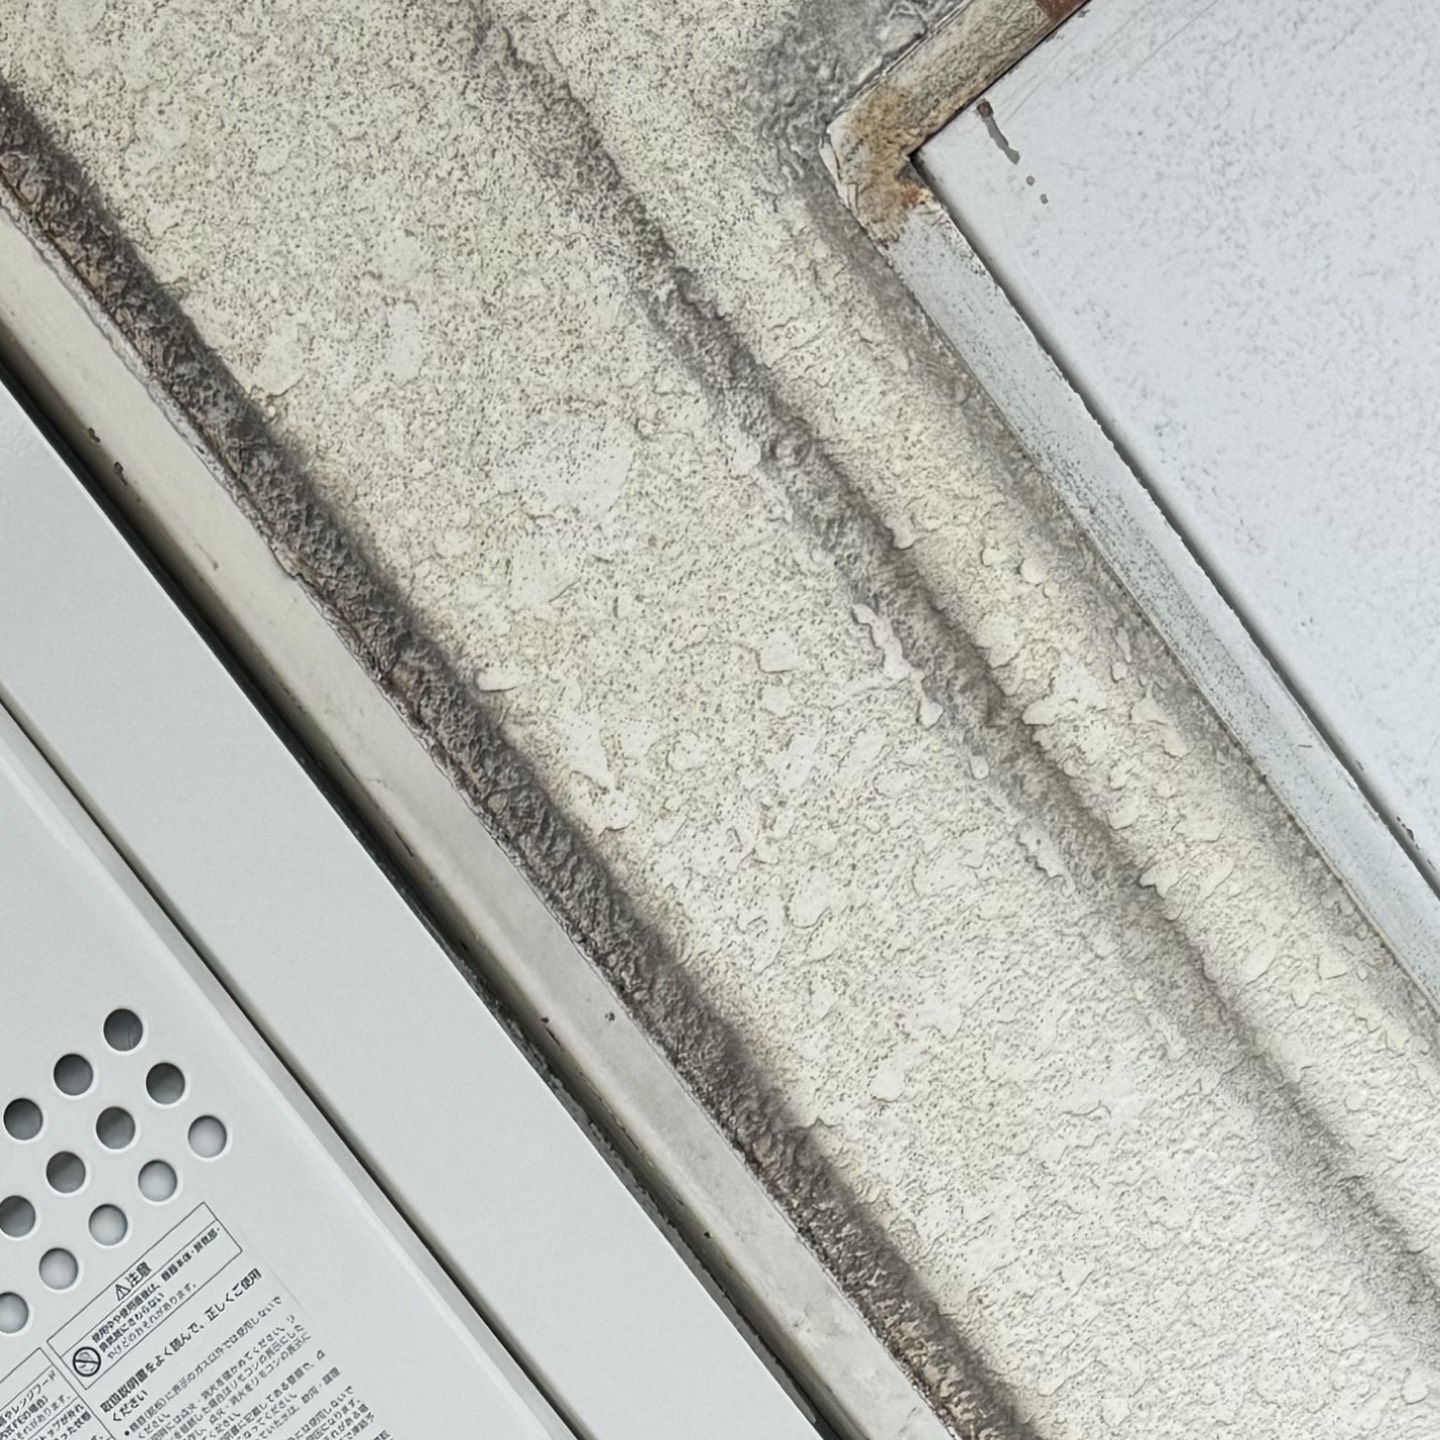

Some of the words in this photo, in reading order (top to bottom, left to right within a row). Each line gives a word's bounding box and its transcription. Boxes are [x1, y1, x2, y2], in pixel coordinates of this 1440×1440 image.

[125, 1260, 152, 1288] 注意
[110, 1387, 149, 1424] ください
